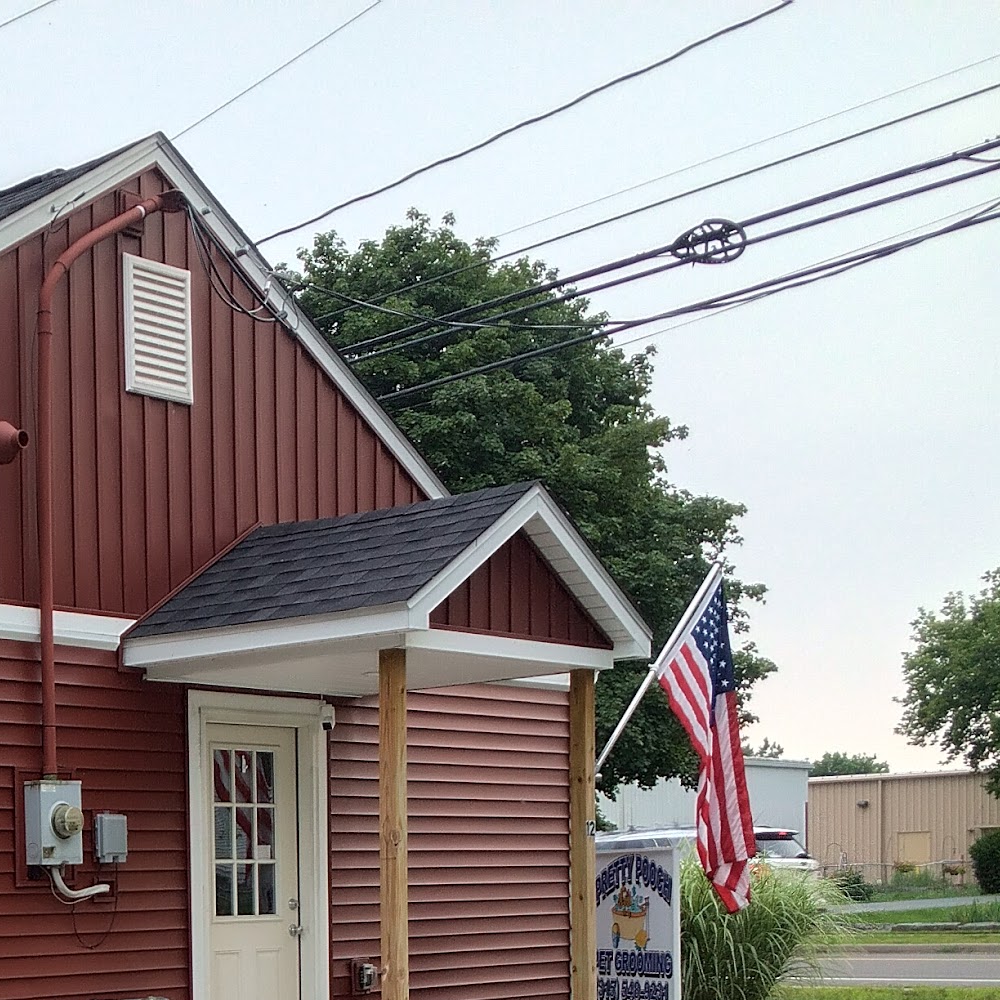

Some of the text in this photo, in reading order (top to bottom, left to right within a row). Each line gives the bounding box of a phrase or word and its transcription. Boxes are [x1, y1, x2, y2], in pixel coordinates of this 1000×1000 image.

[586, 820, 595, 836] 12
[596, 853, 673, 907] PRETTY POOCH
[615, 949, 673, 979] GROOMING
